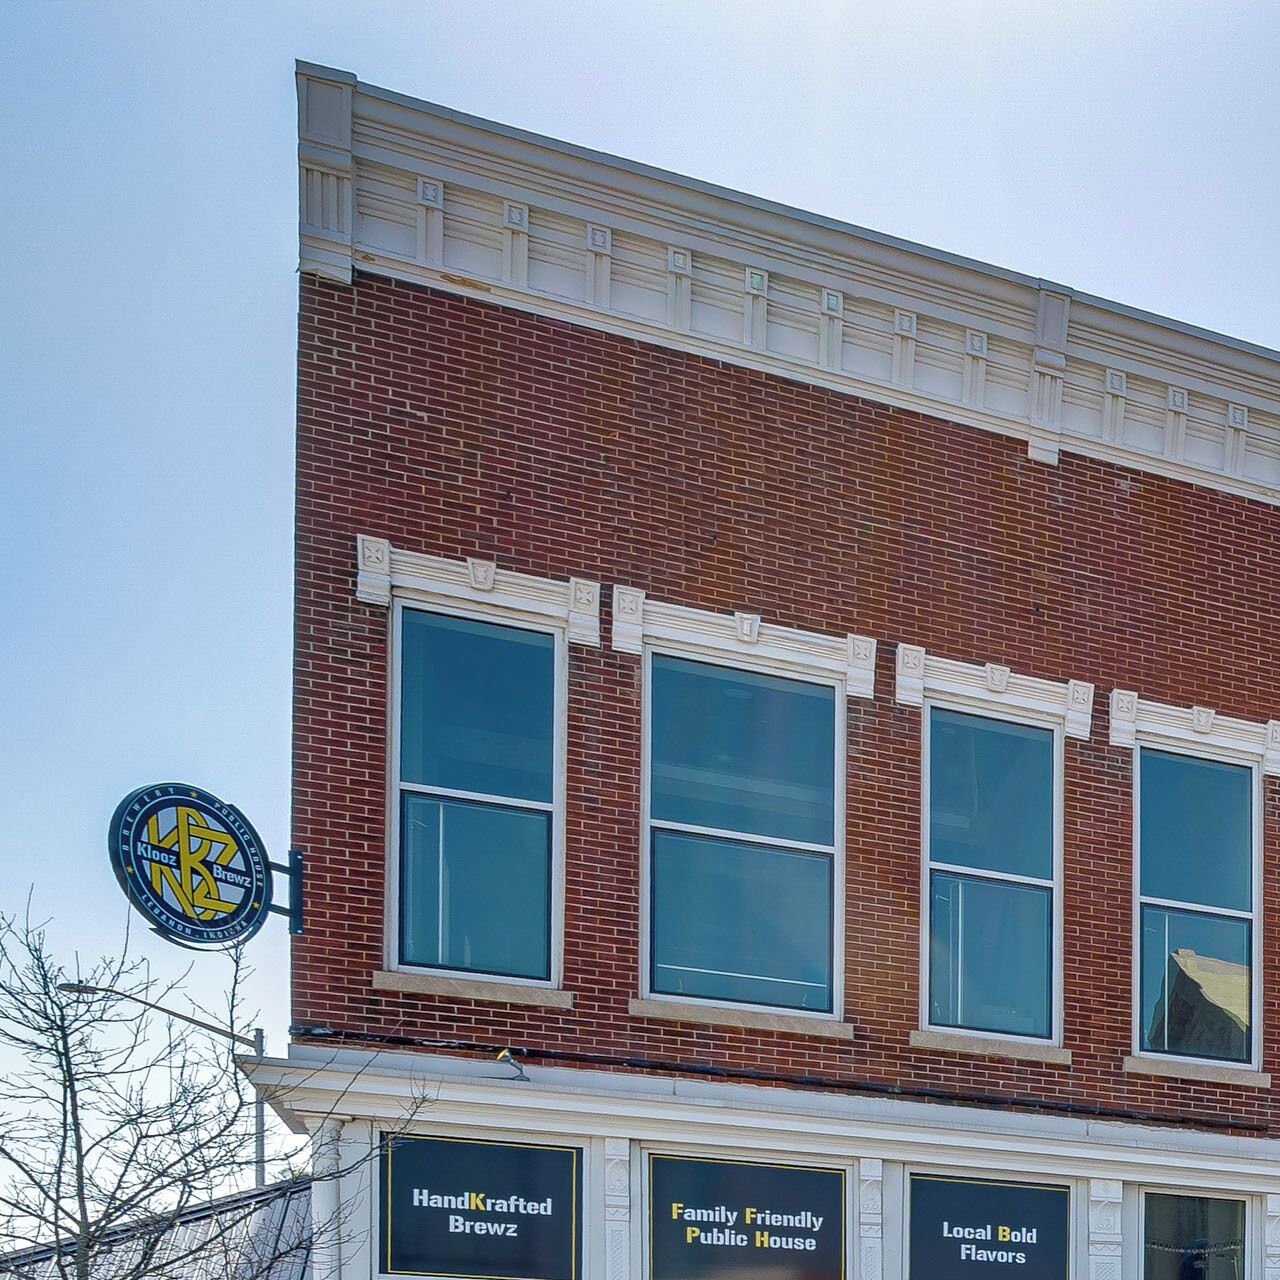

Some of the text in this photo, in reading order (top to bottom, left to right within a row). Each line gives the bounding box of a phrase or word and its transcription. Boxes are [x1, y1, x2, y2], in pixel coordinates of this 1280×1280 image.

[136, 841, 252, 888] Klooz Brewz
[412, 1188, 553, 1216] HandKrafted
[448, 1214, 518, 1237] Brewz
[671, 1202, 824, 1232] Family Friendly
[686, 1226, 817, 1251] Public House
[943, 1221, 1037, 1244] Local Bold
[960, 1244, 1027, 1264] Flavors
